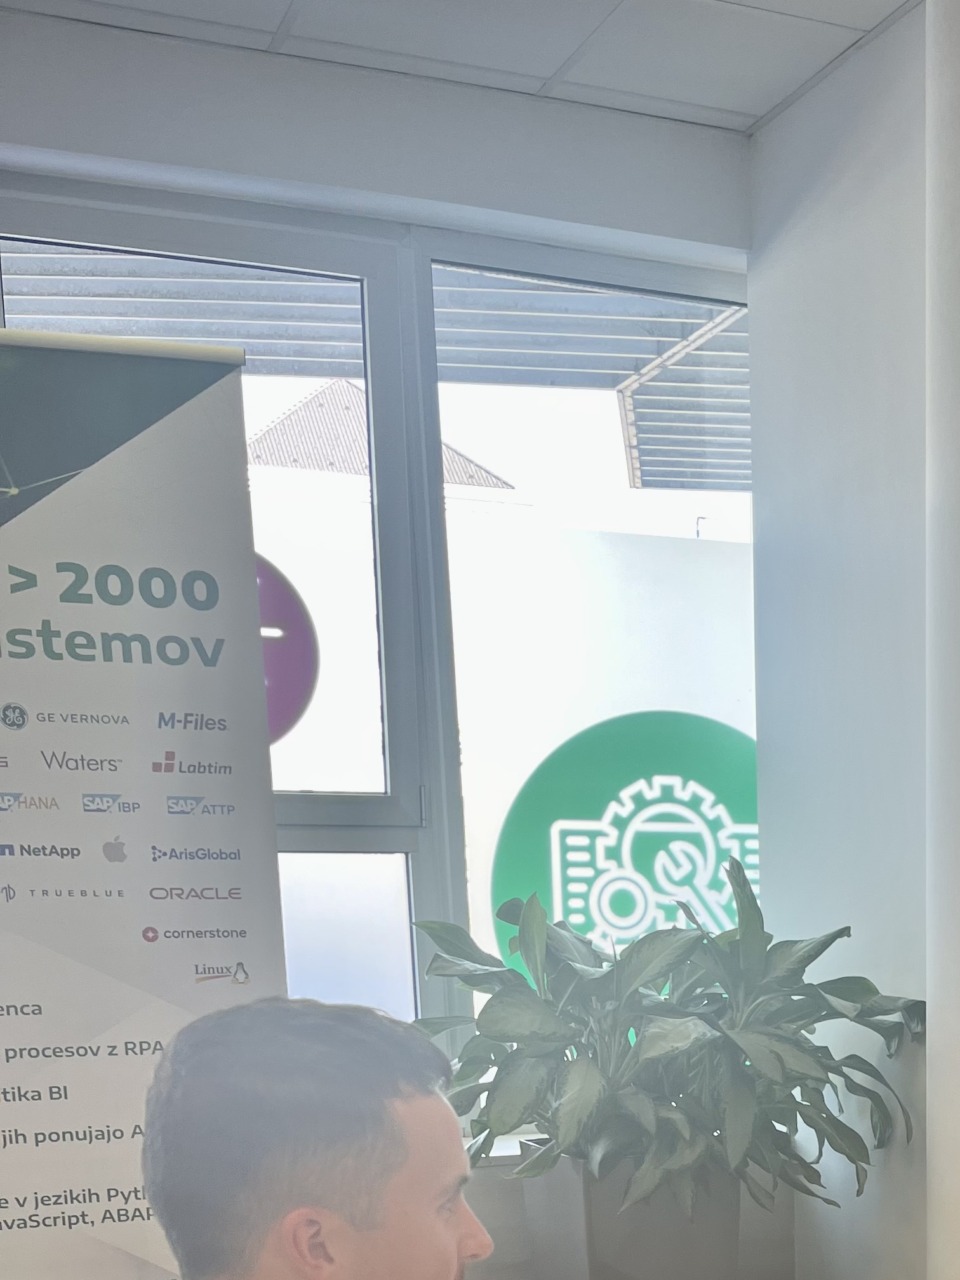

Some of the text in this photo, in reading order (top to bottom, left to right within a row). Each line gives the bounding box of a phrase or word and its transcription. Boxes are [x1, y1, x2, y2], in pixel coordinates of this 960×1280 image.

[56, 562, 220, 612] 2000
[0, 619, 225, 668] stemov
[36, 712, 130, 725] GE VERNOVA
[158, 712, 227, 731] M-Files
[178, 760, 233, 775] Labtim
[18, 796, 60, 810] HANA
[118, 802, 141, 813] IBP
[201, 804, 236, 816] ATTP
[19, 844, 82, 860] NetApp
[168, 848, 241, 861] ArisGlobal
[149, 887, 242, 901] ORACLE
[163, 927, 247, 939] cornerstone
[194, 964, 233, 976] Linux
[4, 1040, 164, 1063] procesov z RPA
[1, 1085, 69, 1103] tika BI
[1, 1128, 27, 1149] jih
[34, 1125, 125, 1147] ponujajo
[14, 1197, 28, 1208] v
[34, 1188, 100, 1211] jezikih
[0, 1211, 96, 1231] vaScript,
